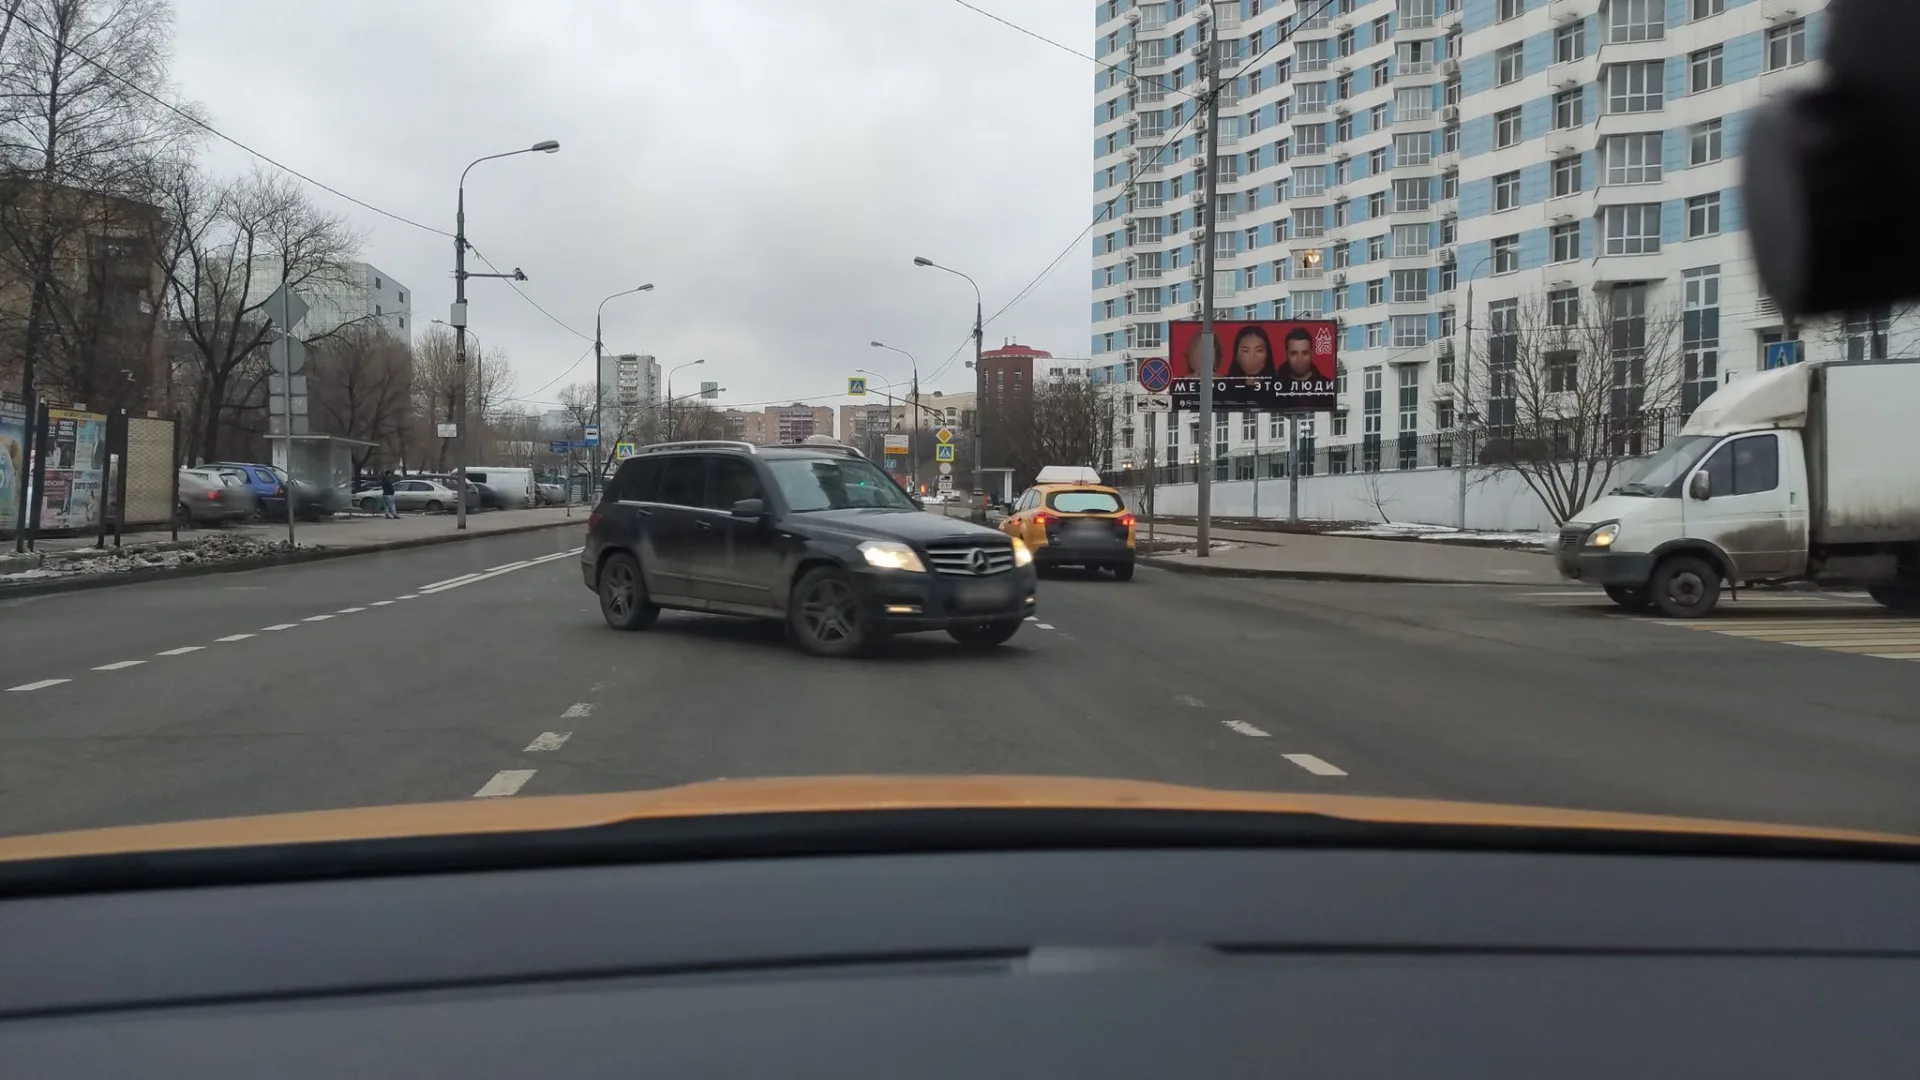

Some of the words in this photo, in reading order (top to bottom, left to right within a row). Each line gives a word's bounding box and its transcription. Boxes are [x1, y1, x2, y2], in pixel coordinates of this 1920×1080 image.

[1174, 381, 1226, 392] МЕО
[1253, 381, 1283, 391] ЭТО
[1290, 381, 1334, 392] ЛЮДИ
